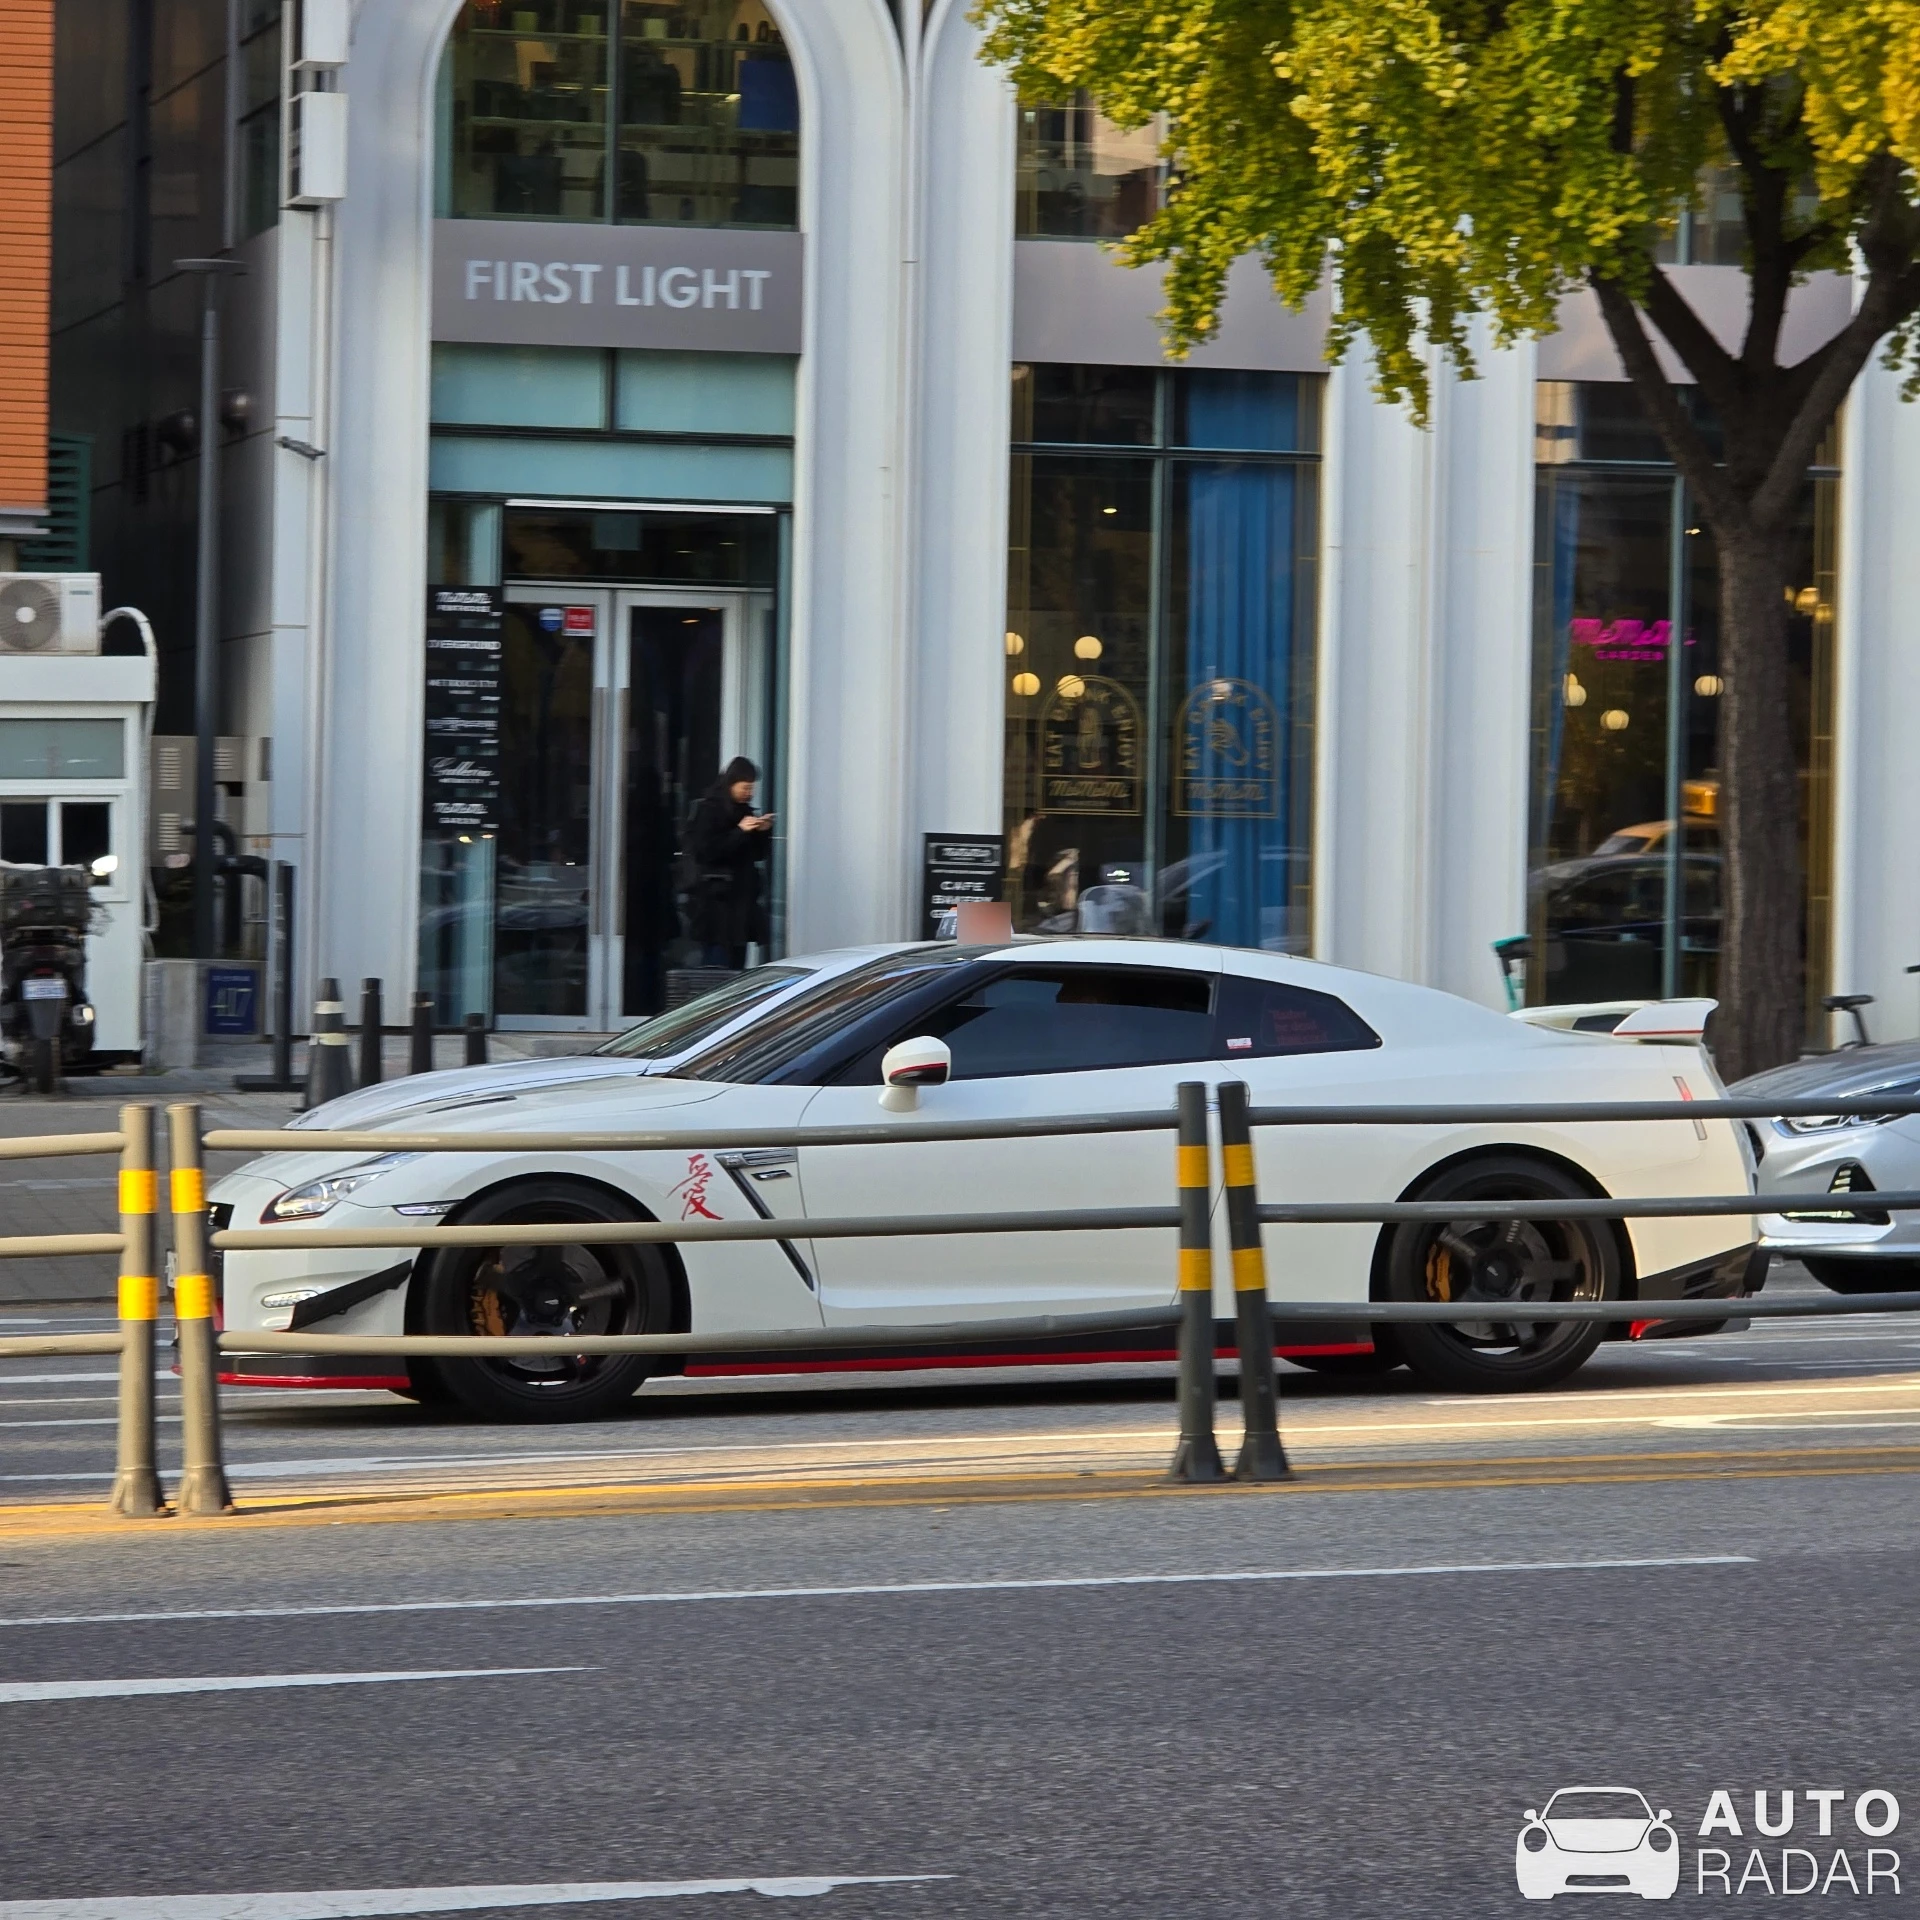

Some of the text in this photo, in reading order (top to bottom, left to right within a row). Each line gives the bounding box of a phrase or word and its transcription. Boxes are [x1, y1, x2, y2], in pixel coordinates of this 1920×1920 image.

[465, 259, 772, 310] FIRST LIGHT
[940, 881, 986, 891] CAFE
[666, 1153, 724, 1221] 愛
